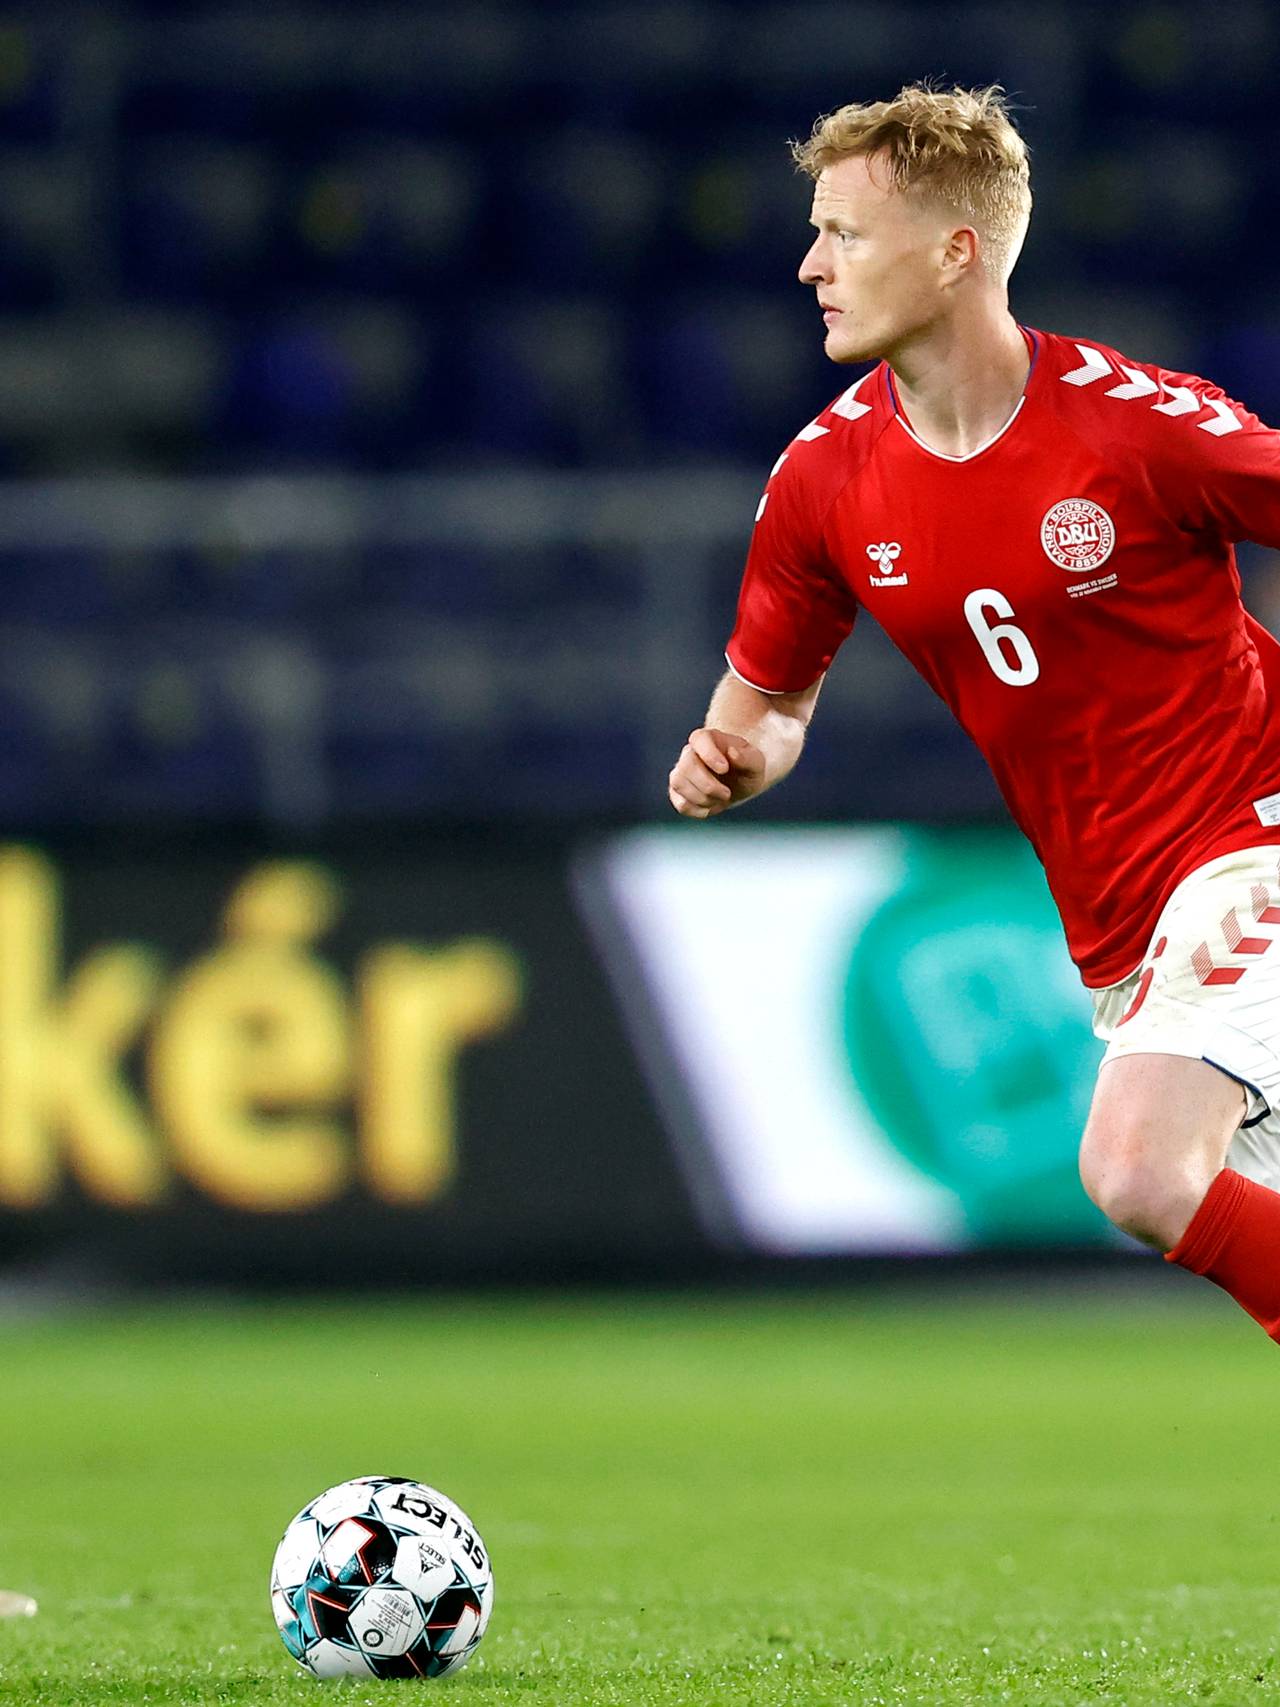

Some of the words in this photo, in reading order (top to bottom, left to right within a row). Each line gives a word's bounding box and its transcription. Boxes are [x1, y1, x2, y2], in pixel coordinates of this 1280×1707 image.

[1045, 524, 1067, 563] DANSK
[1098, 518, 1111, 556] UNION
[1057, 522, 1099, 546] DBU
[1070, 555, 1098, 568] 1889
[964, 588, 1039, 687] 6
[390, 1493, 485, 1570] SELECT
[420, 1542, 447, 1565] SELECT
